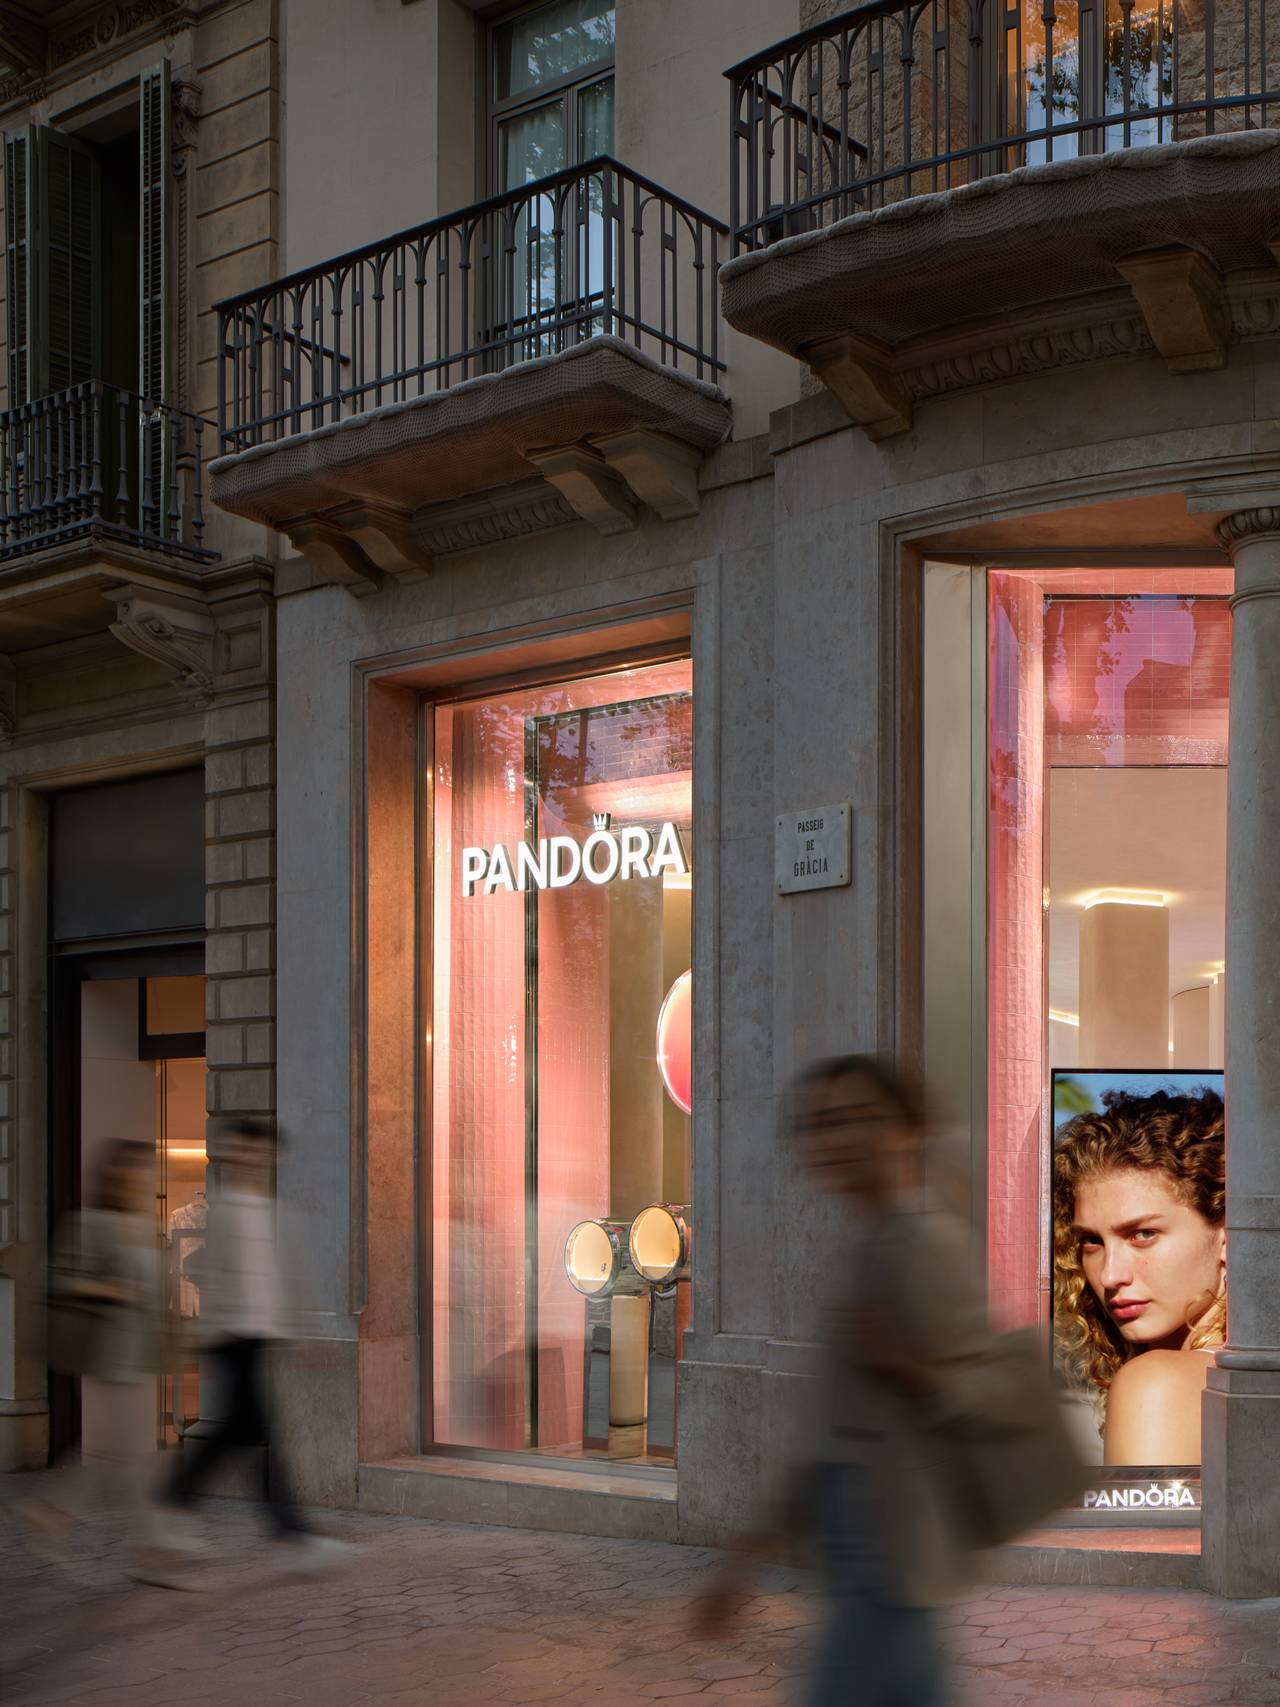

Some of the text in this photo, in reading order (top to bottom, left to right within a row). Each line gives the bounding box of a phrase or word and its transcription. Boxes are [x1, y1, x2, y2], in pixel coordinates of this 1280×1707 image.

[797, 818, 824, 833] PASSEIG
[806, 839, 815, 851] DE
[462, 820, 688, 897] PANDORA
[793, 856, 828, 877] GRÀCIA
[1083, 1487, 1195, 1507] PANDORA
